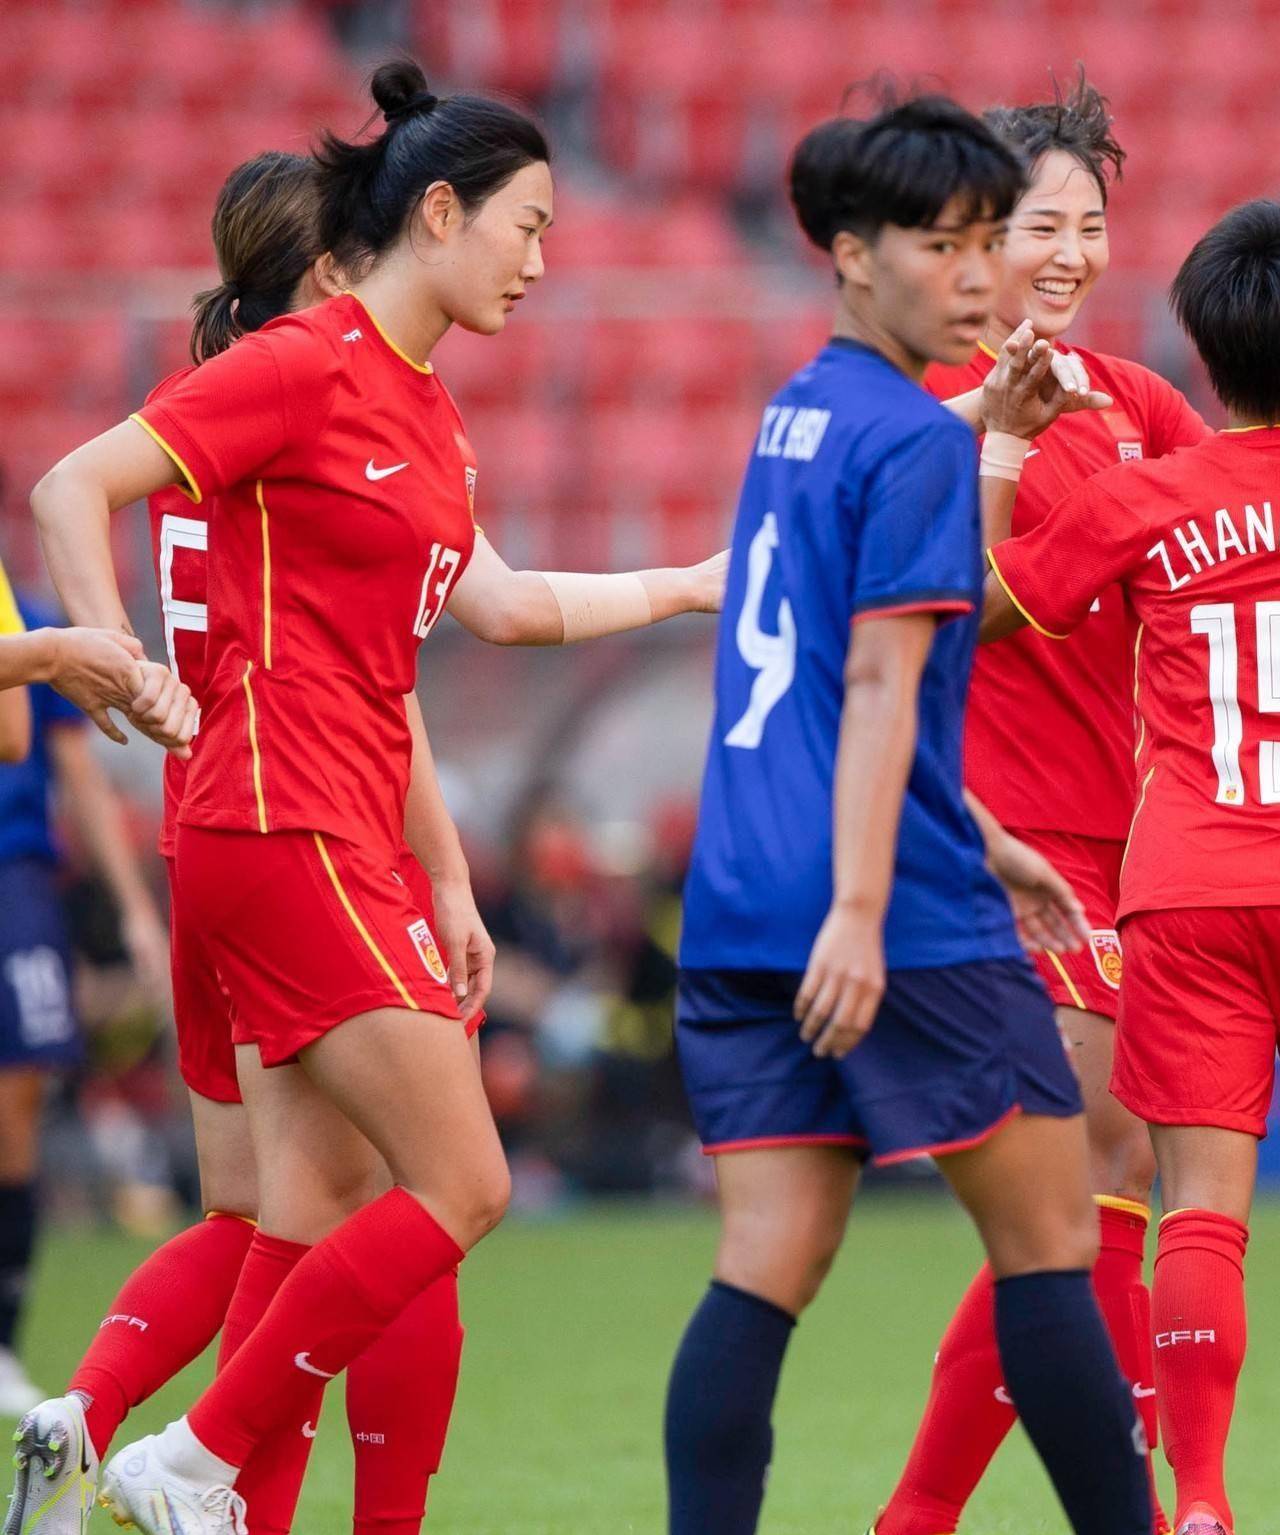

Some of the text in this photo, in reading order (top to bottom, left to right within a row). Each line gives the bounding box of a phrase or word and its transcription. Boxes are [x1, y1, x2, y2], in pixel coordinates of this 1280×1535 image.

[412, 542, 461, 640] 13
[724, 512, 797, 751] 4
[100, 1314, 148, 1332] CFA
[1156, 1329, 1215, 1348] CFA
[356, 1432, 385, 1444] 中国
